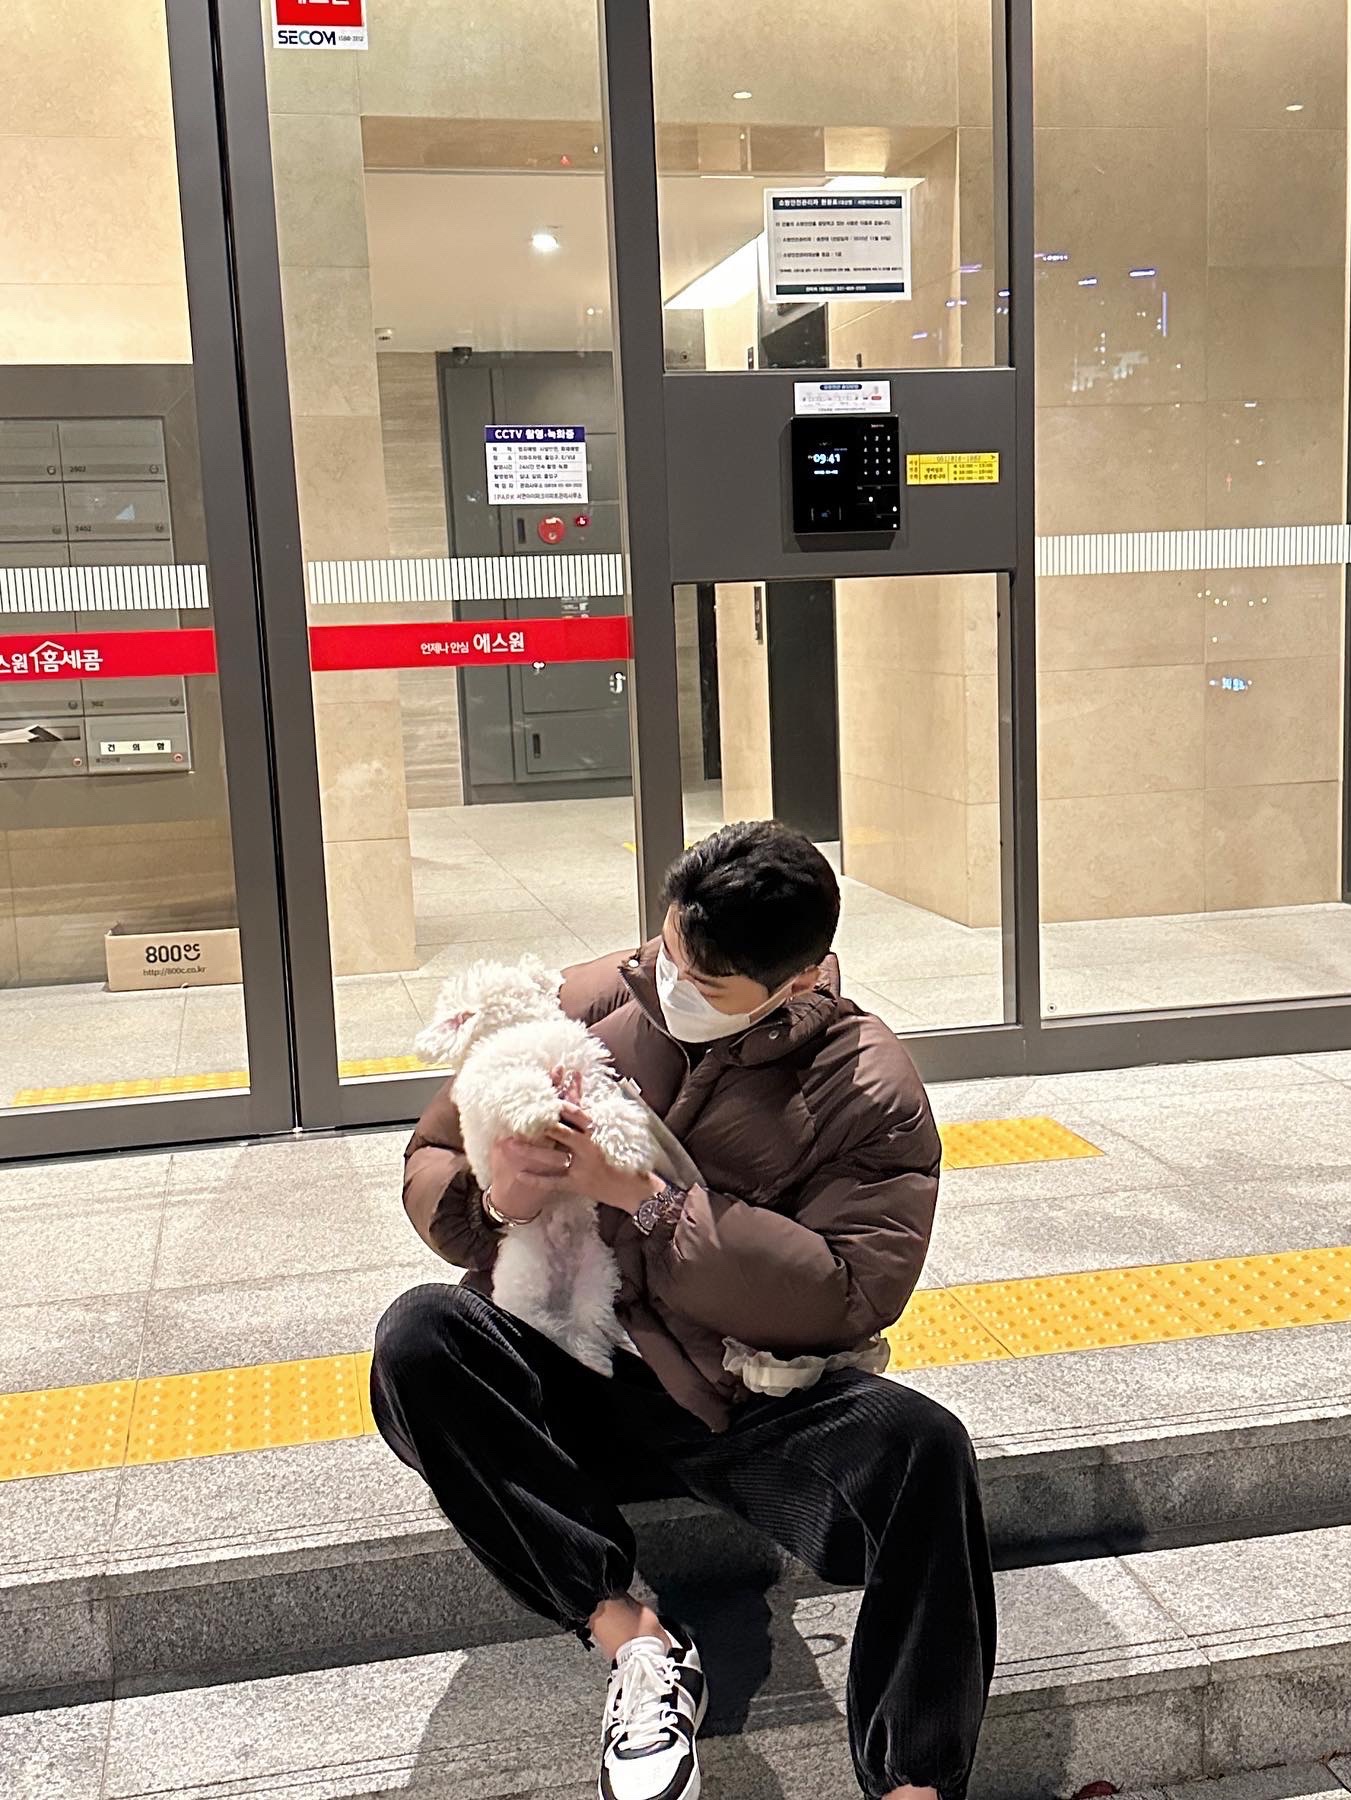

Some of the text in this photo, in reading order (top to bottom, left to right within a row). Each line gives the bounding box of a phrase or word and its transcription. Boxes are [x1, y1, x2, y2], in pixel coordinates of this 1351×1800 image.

[277, 30, 337, 45] SECOM
[494, 429, 522, 440] CCTV
[813, 453, 840, 464] 09:41
[420, 632, 525, 655] 언제나 안심 에스원
[37, 647, 103, 673] 홈세콤
